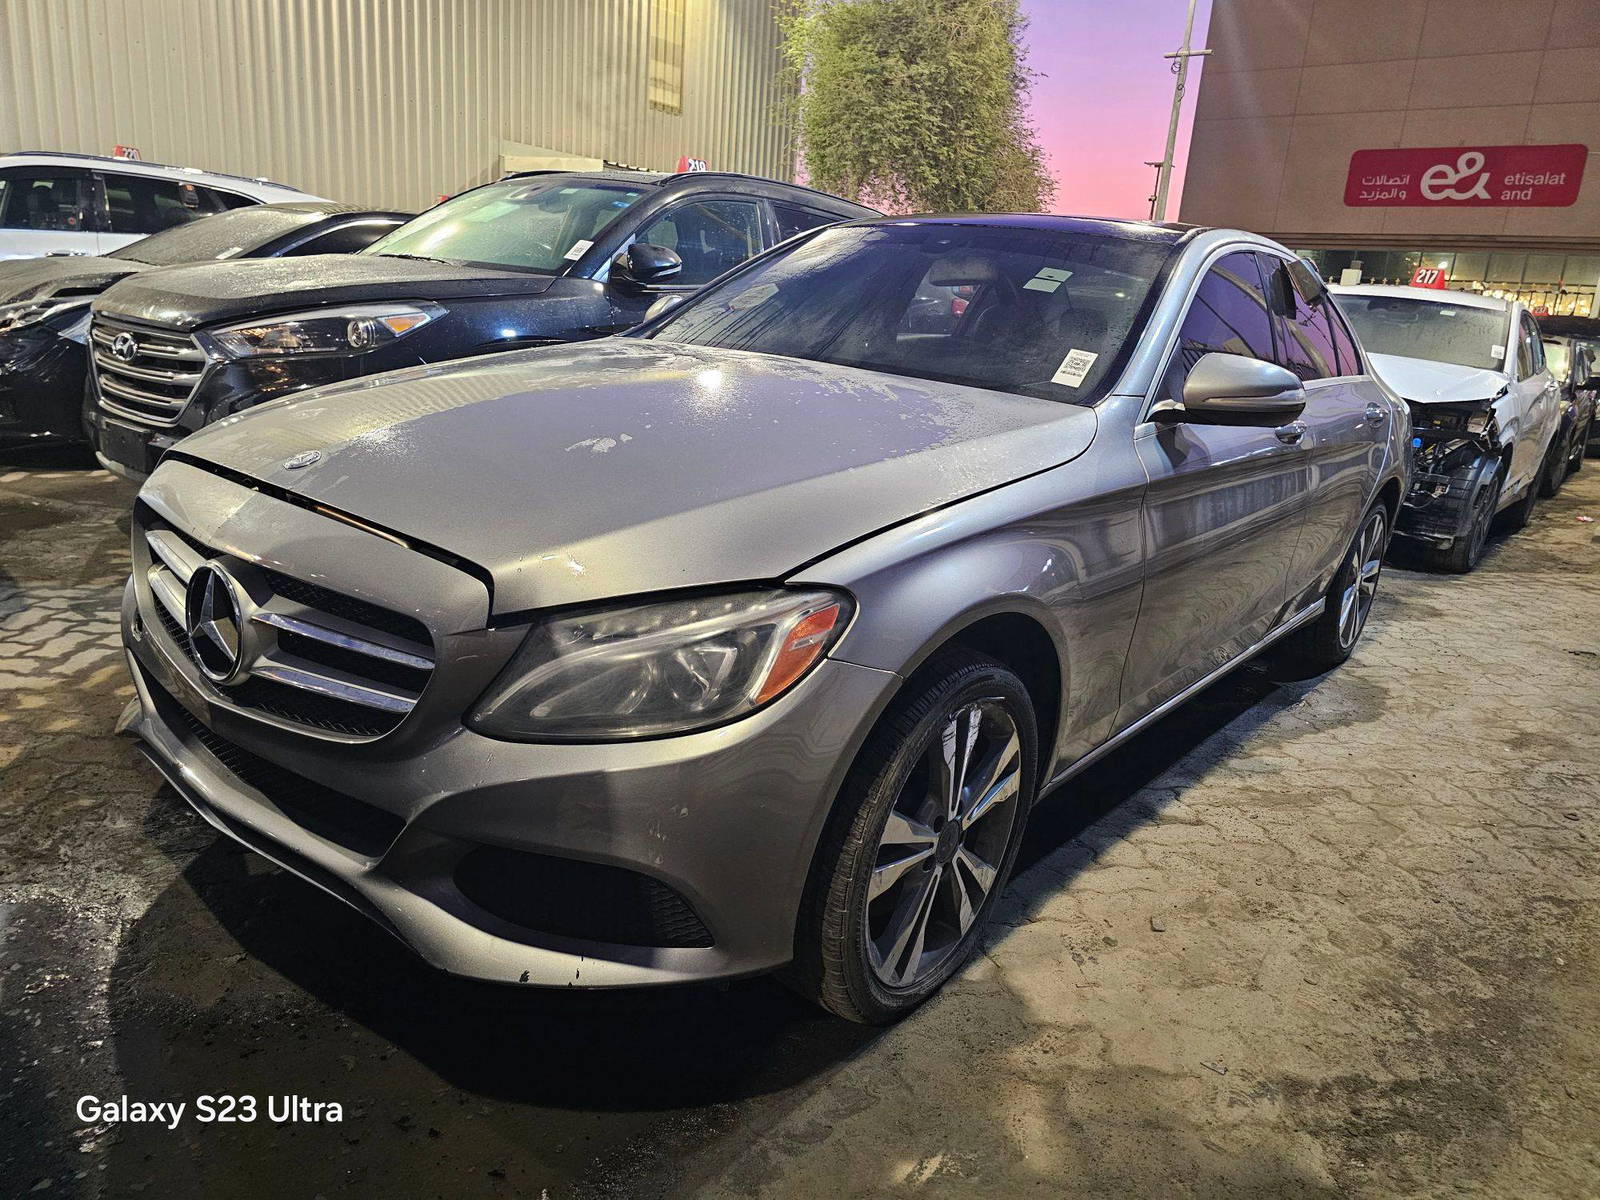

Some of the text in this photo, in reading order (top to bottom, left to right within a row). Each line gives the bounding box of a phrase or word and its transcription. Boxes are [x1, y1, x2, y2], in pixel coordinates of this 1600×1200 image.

[1362, 174, 1409, 185] اتصالات
[1420, 151, 1492, 201] e&
[1504, 172, 1566, 185] etisalat
[1359, 188, 1407, 201] والمزيد
[1500, 187, 1533, 201] and
[1415, 269, 1439, 284] 217
